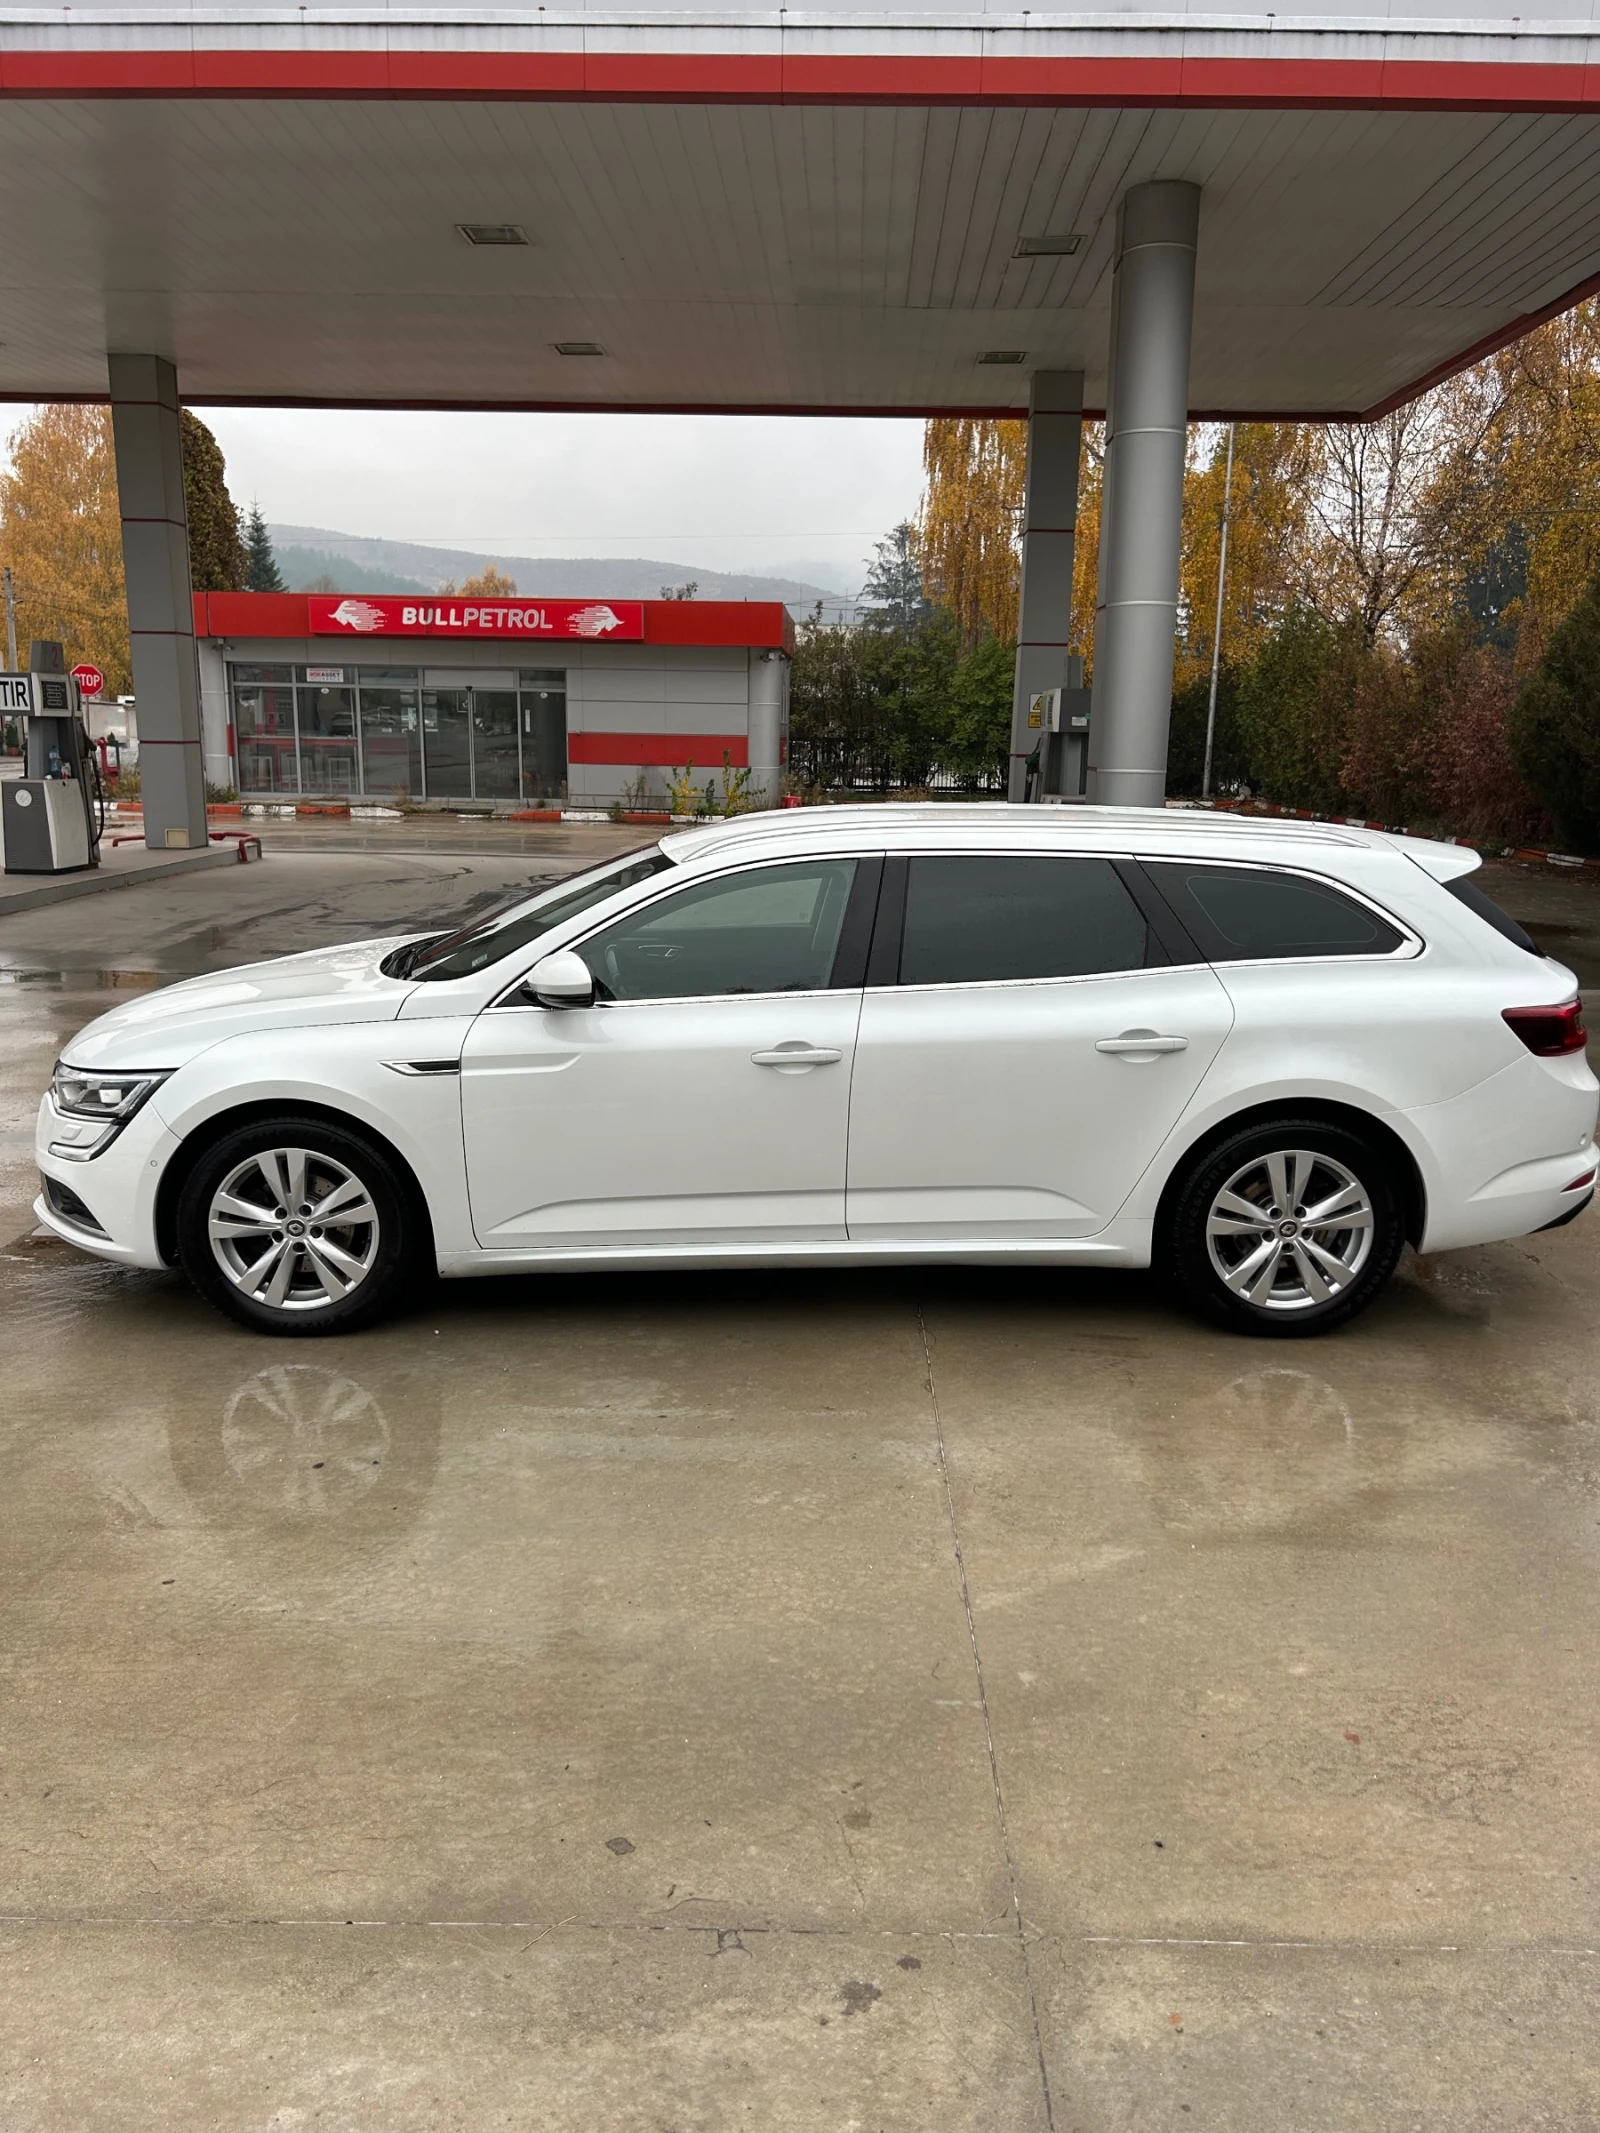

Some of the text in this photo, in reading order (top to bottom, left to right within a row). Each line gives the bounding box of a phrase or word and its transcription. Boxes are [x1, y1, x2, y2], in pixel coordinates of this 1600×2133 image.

[402, 607, 553, 629] BULLPETROL
[52, 646, 58, 668] 2
[0, 681, 28, 707] TIR
